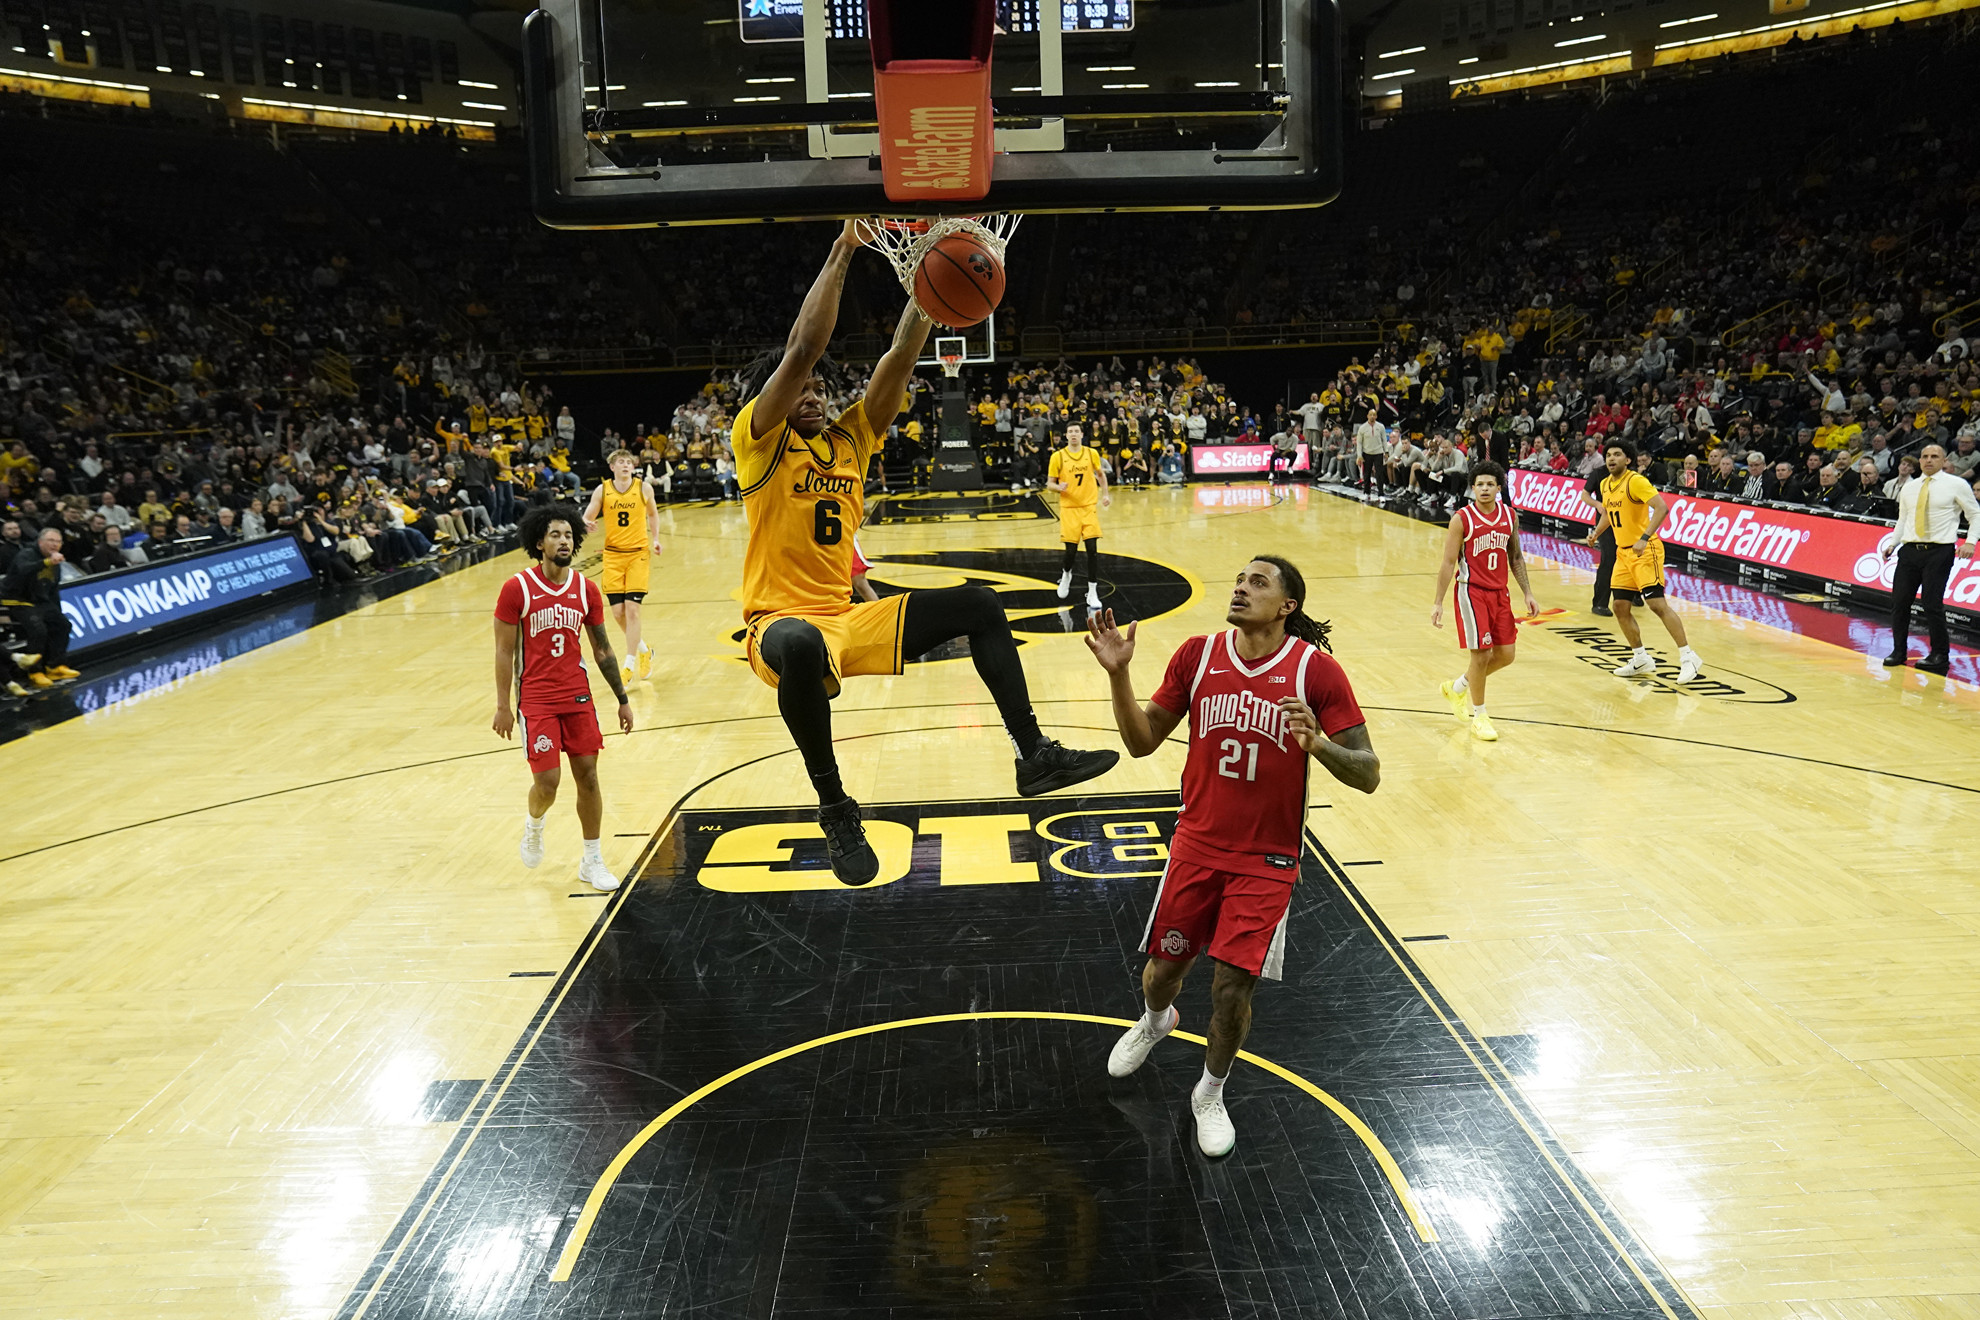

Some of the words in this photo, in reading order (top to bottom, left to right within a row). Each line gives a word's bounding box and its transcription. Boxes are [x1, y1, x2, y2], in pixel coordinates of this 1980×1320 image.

[774, 4, 803, 16] Energ
[1063, 4, 1078, 18] 60
[1084, 4, 1109, 18] 8:39
[1114, 3, 1129, 17] 43
[793, 467, 854, 495] Iowa
[1074, 473, 1084, 487] 7
[610, 499, 636, 510] Iowa
[617, 511, 630, 527] 8
[814, 499, 842, 546] 6
[1609, 510, 1623, 528] 11
[234, 558, 247, 571] IN
[244, 554, 264, 569] THE
[259, 545, 298, 565] BUSINESS
[1487, 552, 1498, 571] 0
[216, 579, 231, 594] OF
[228, 570, 265, 591] HELPING
[83, 569, 213, 630] HONKAMP
[550, 633, 565, 658] 3
[1218, 738, 1260, 782] 21
